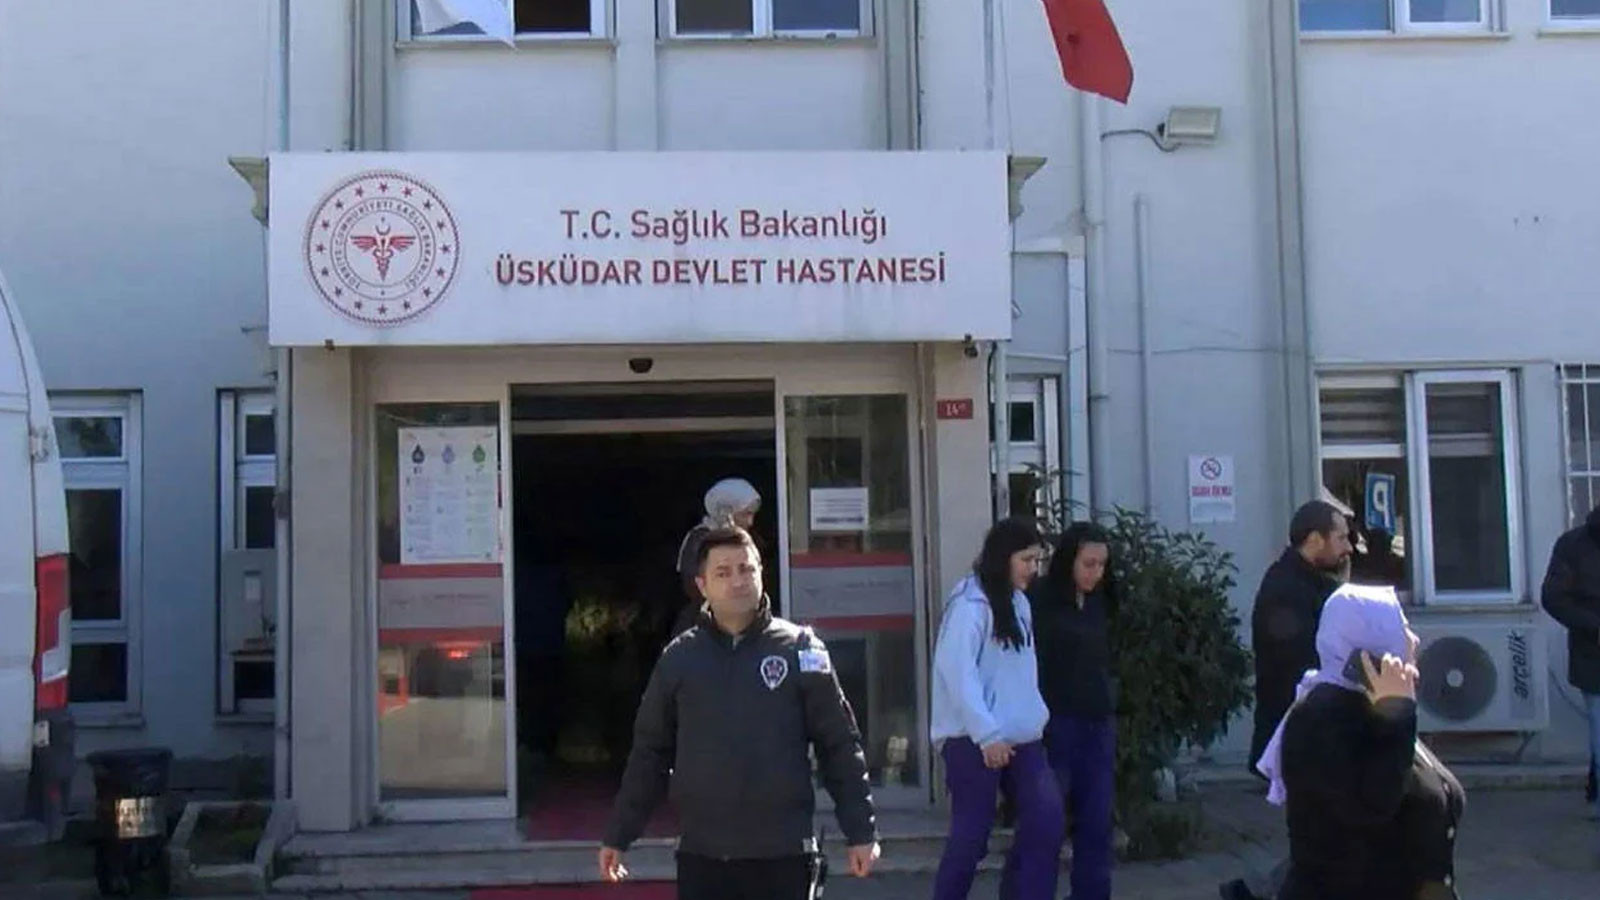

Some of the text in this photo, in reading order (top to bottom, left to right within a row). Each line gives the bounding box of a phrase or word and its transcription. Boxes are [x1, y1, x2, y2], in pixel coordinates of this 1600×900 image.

[560, 207, 888, 246] T.C. Sağlık Bakanlığı
[495, 251, 946, 286] ÜSKÜDAR DEVLET HASTANESİ
[1507, 628, 1529, 700] arçelik
